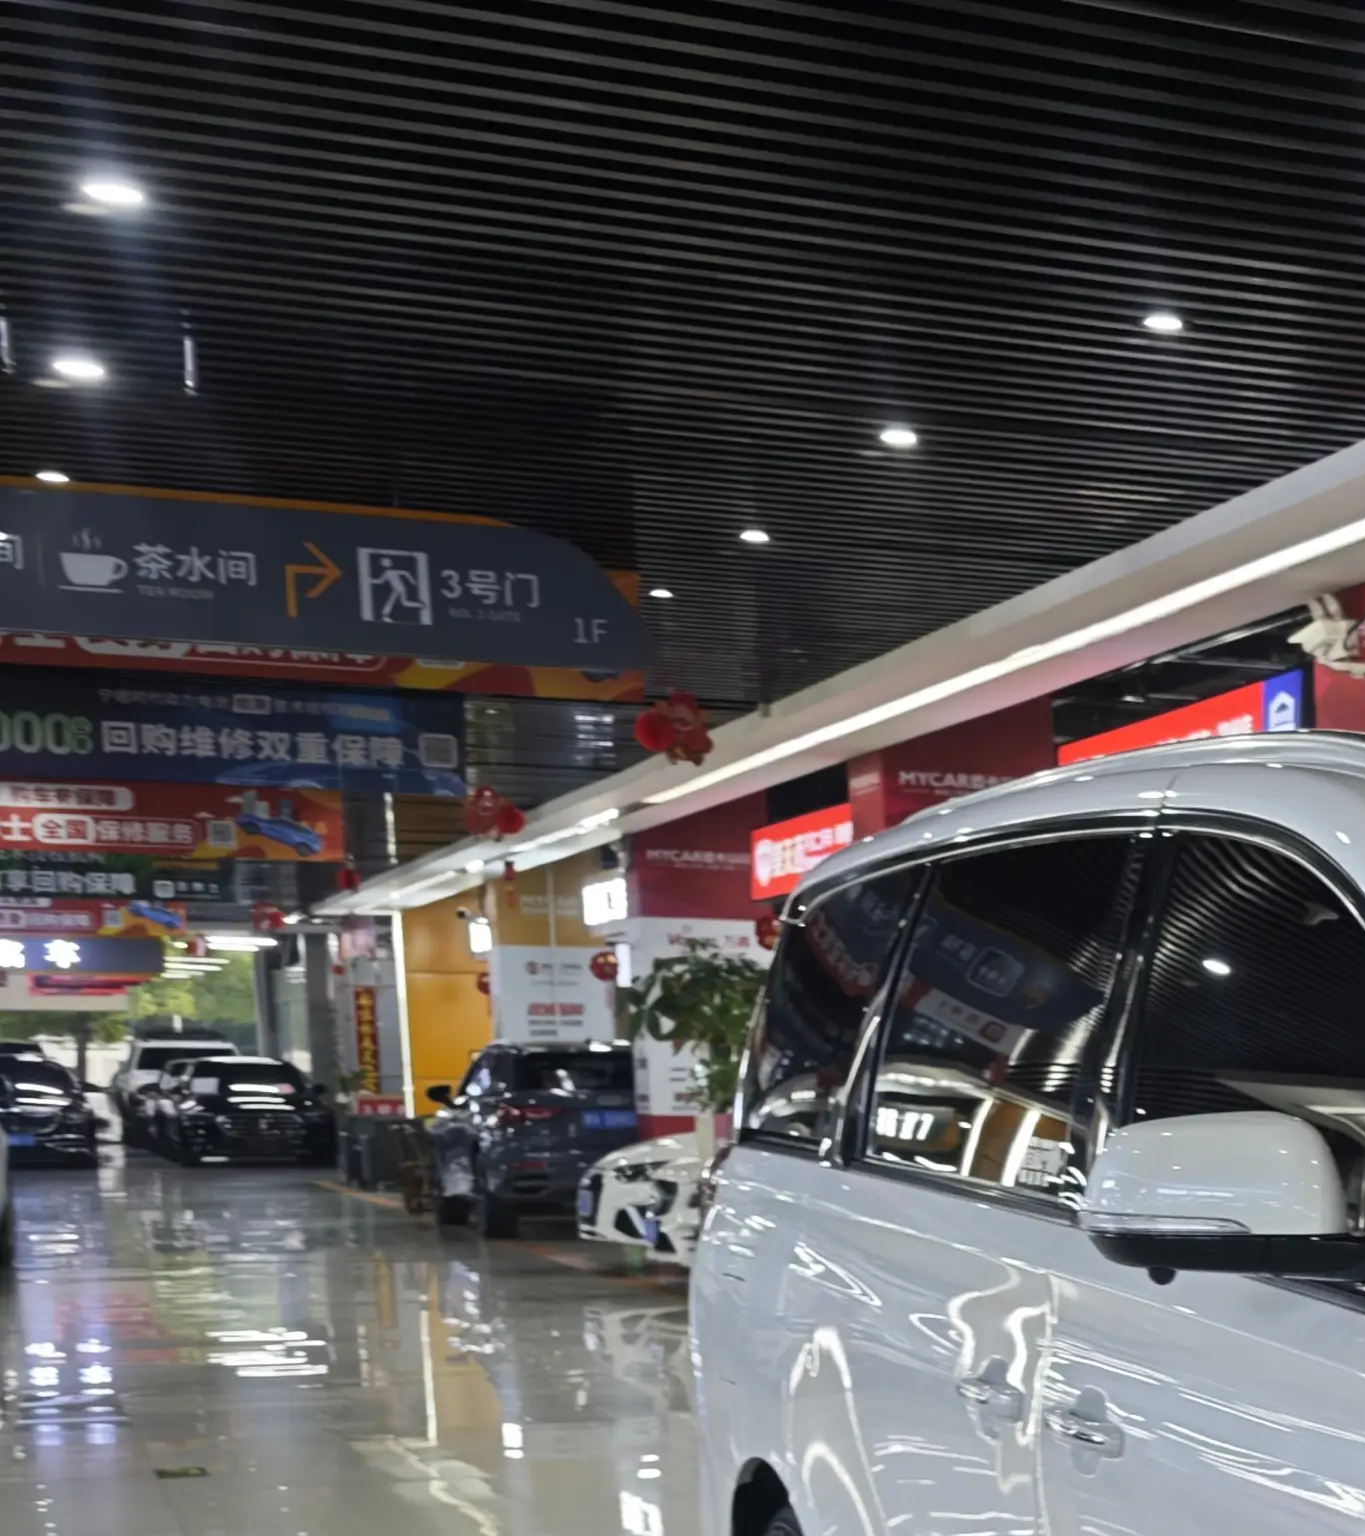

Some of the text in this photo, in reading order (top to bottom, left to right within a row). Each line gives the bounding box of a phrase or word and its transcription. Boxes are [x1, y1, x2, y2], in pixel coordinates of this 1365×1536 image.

[132, 542, 258, 587] 茶水间
[440, 569, 540, 609] 3号门
[573, 616, 610, 644] 1F
[101, 719, 405, 769] 回购维修双重保障
